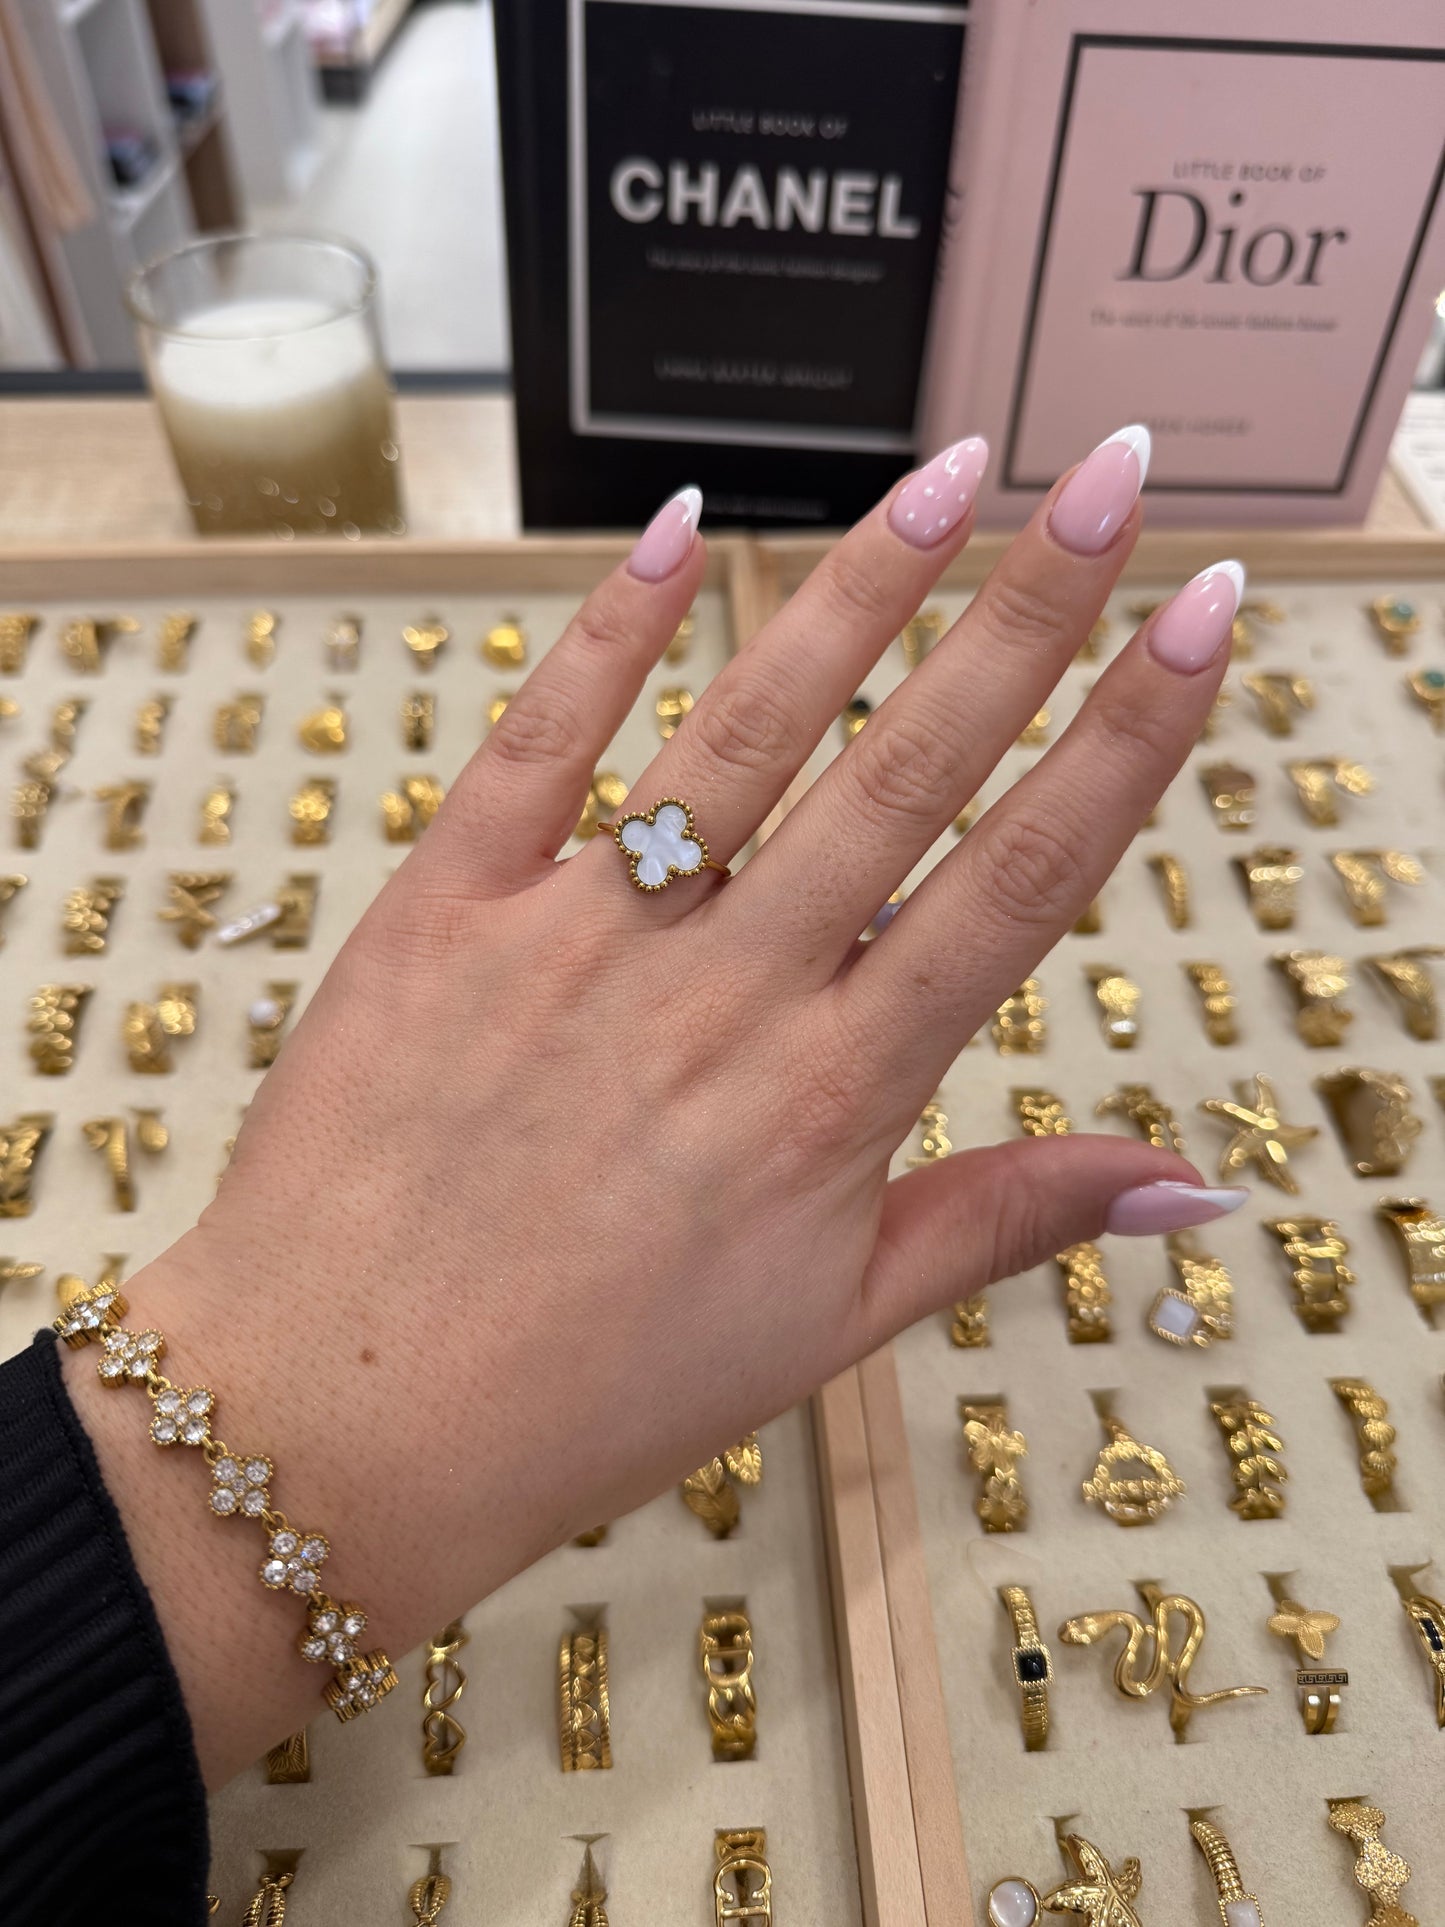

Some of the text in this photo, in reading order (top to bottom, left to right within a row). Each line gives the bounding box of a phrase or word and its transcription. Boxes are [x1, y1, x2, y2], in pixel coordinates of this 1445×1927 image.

[759, 110, 815, 137] BOOK
[818, 113, 848, 139] OF
[609, 155, 921, 239] CHANEL
[1172, 161, 1328, 183] LITTLE BOOK OF
[1114, 184, 1349, 287] Dior
